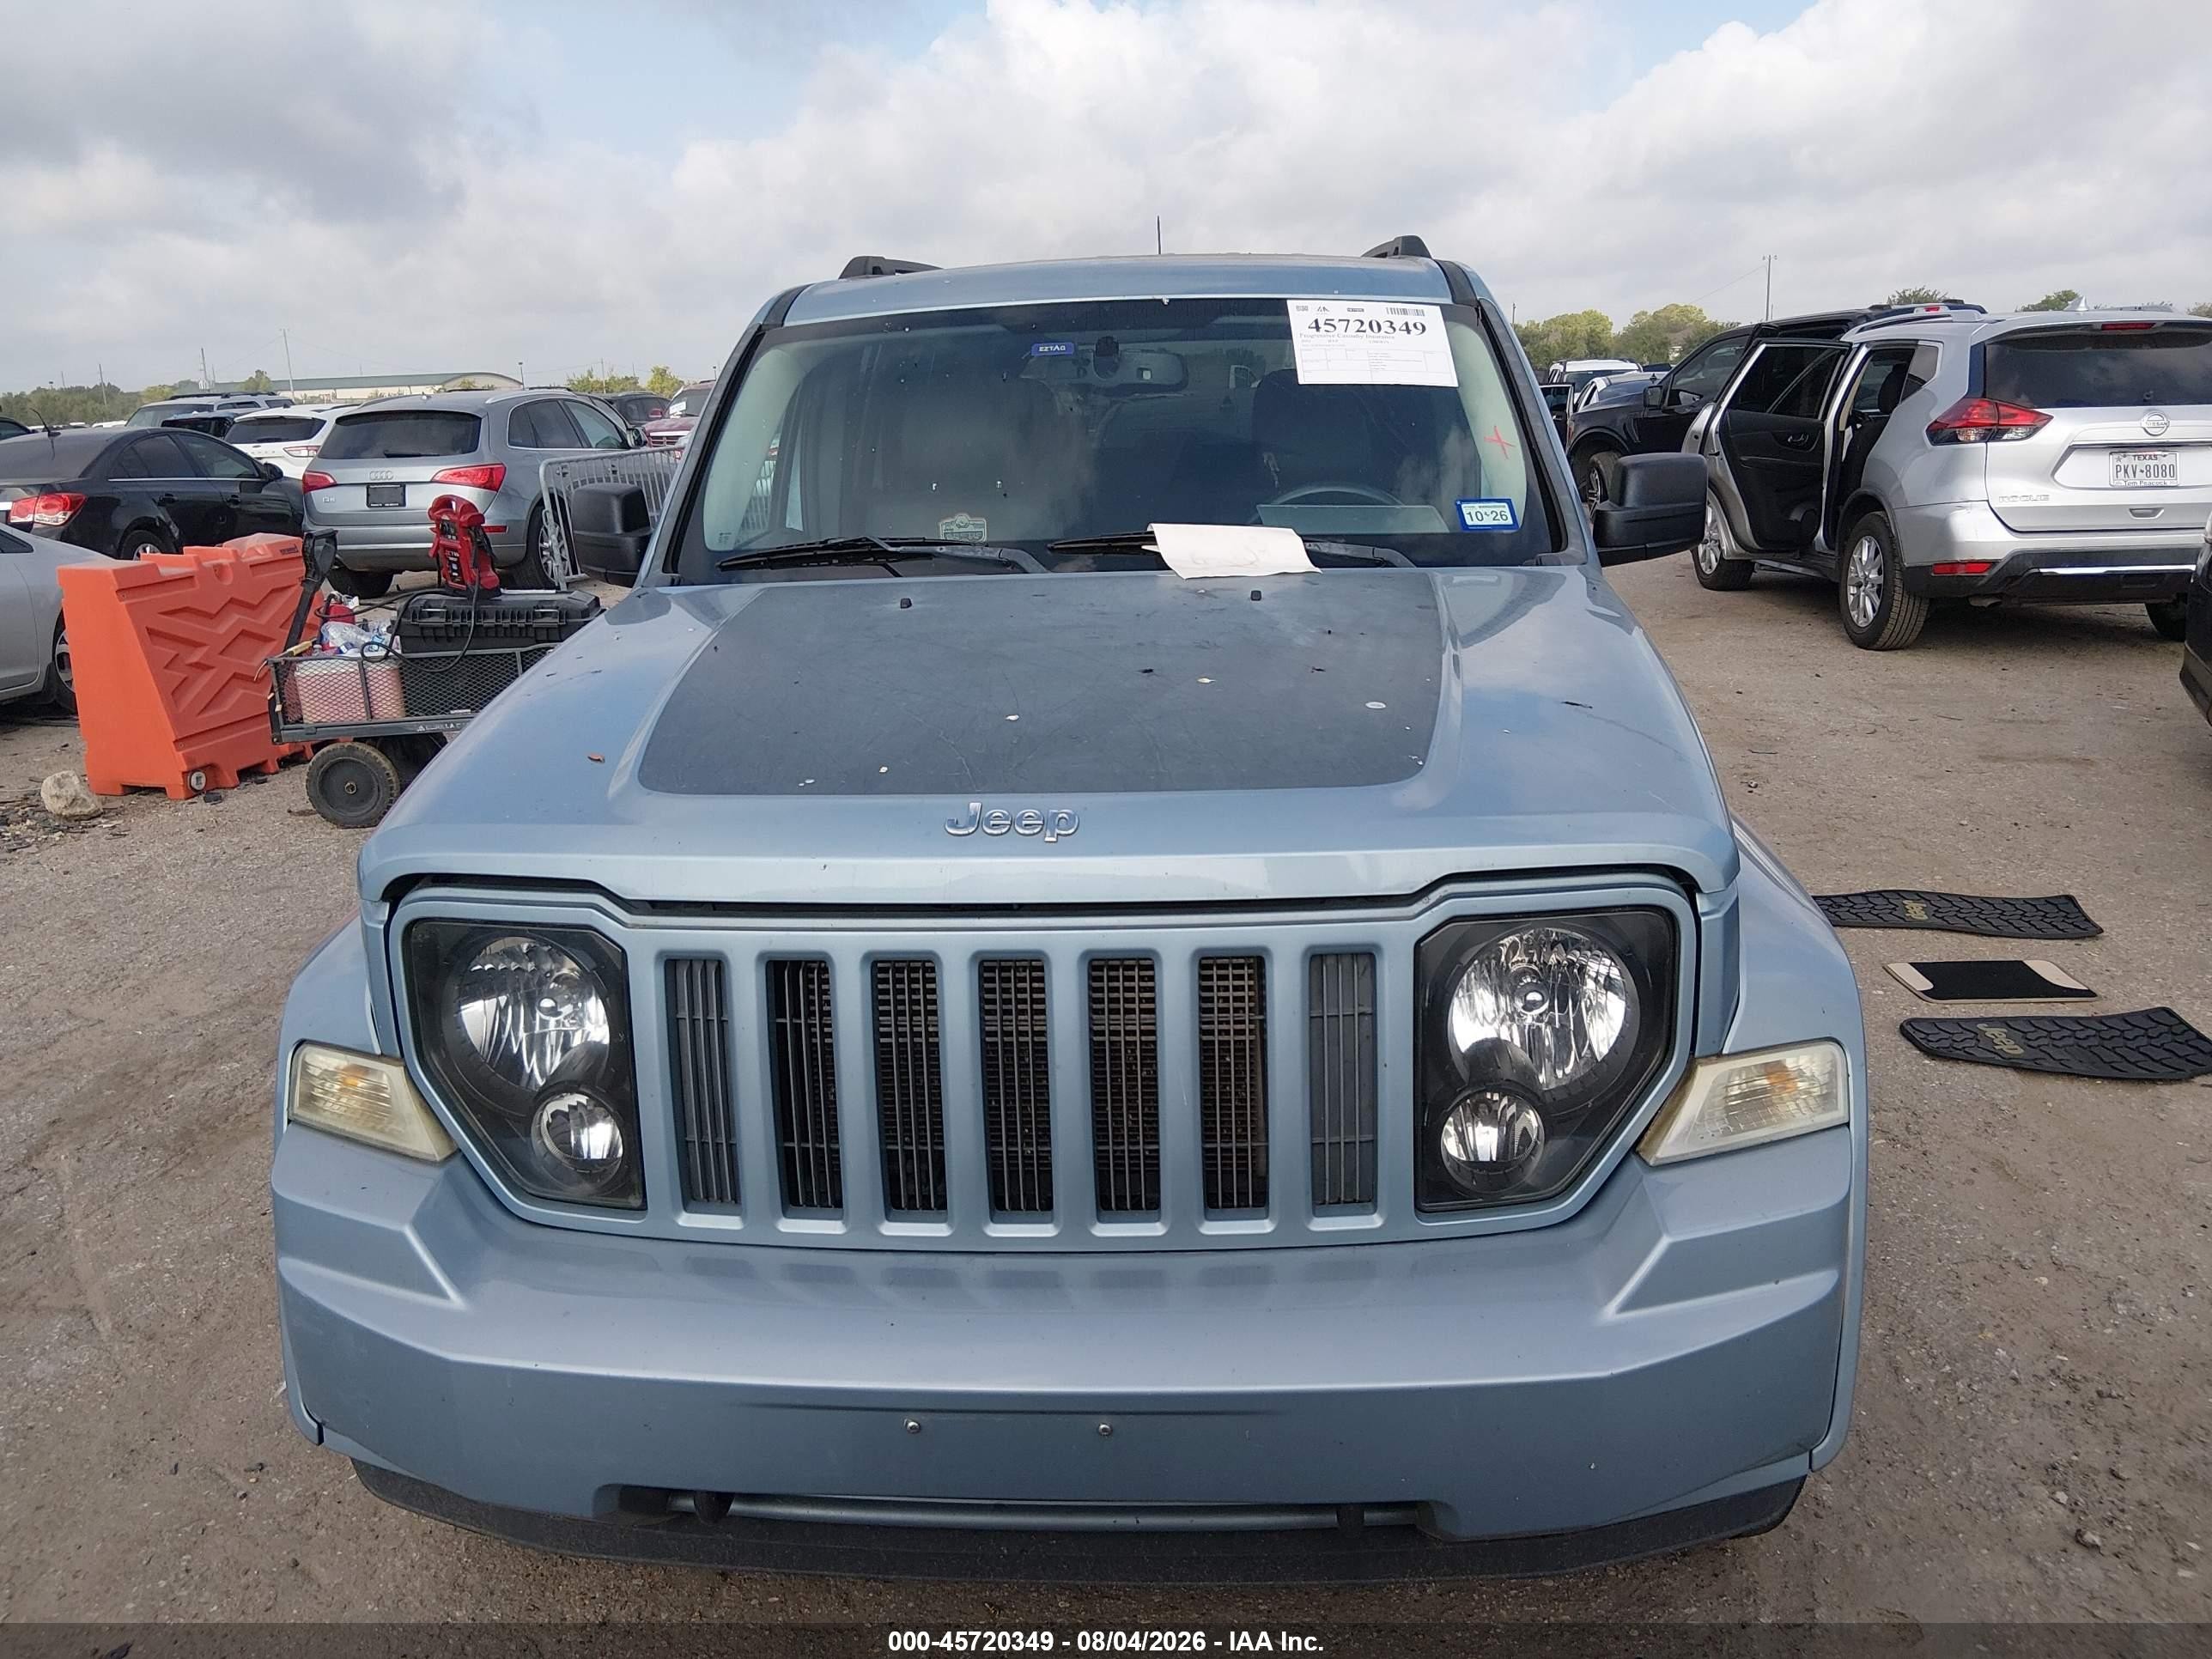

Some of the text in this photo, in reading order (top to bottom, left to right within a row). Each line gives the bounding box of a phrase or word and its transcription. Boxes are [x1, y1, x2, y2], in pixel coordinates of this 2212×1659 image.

[1308, 318, 1426, 336] 45720349
[945, 802, 1079, 842] Jeep
[1977, 1023, 2025, 1054] Jeep
